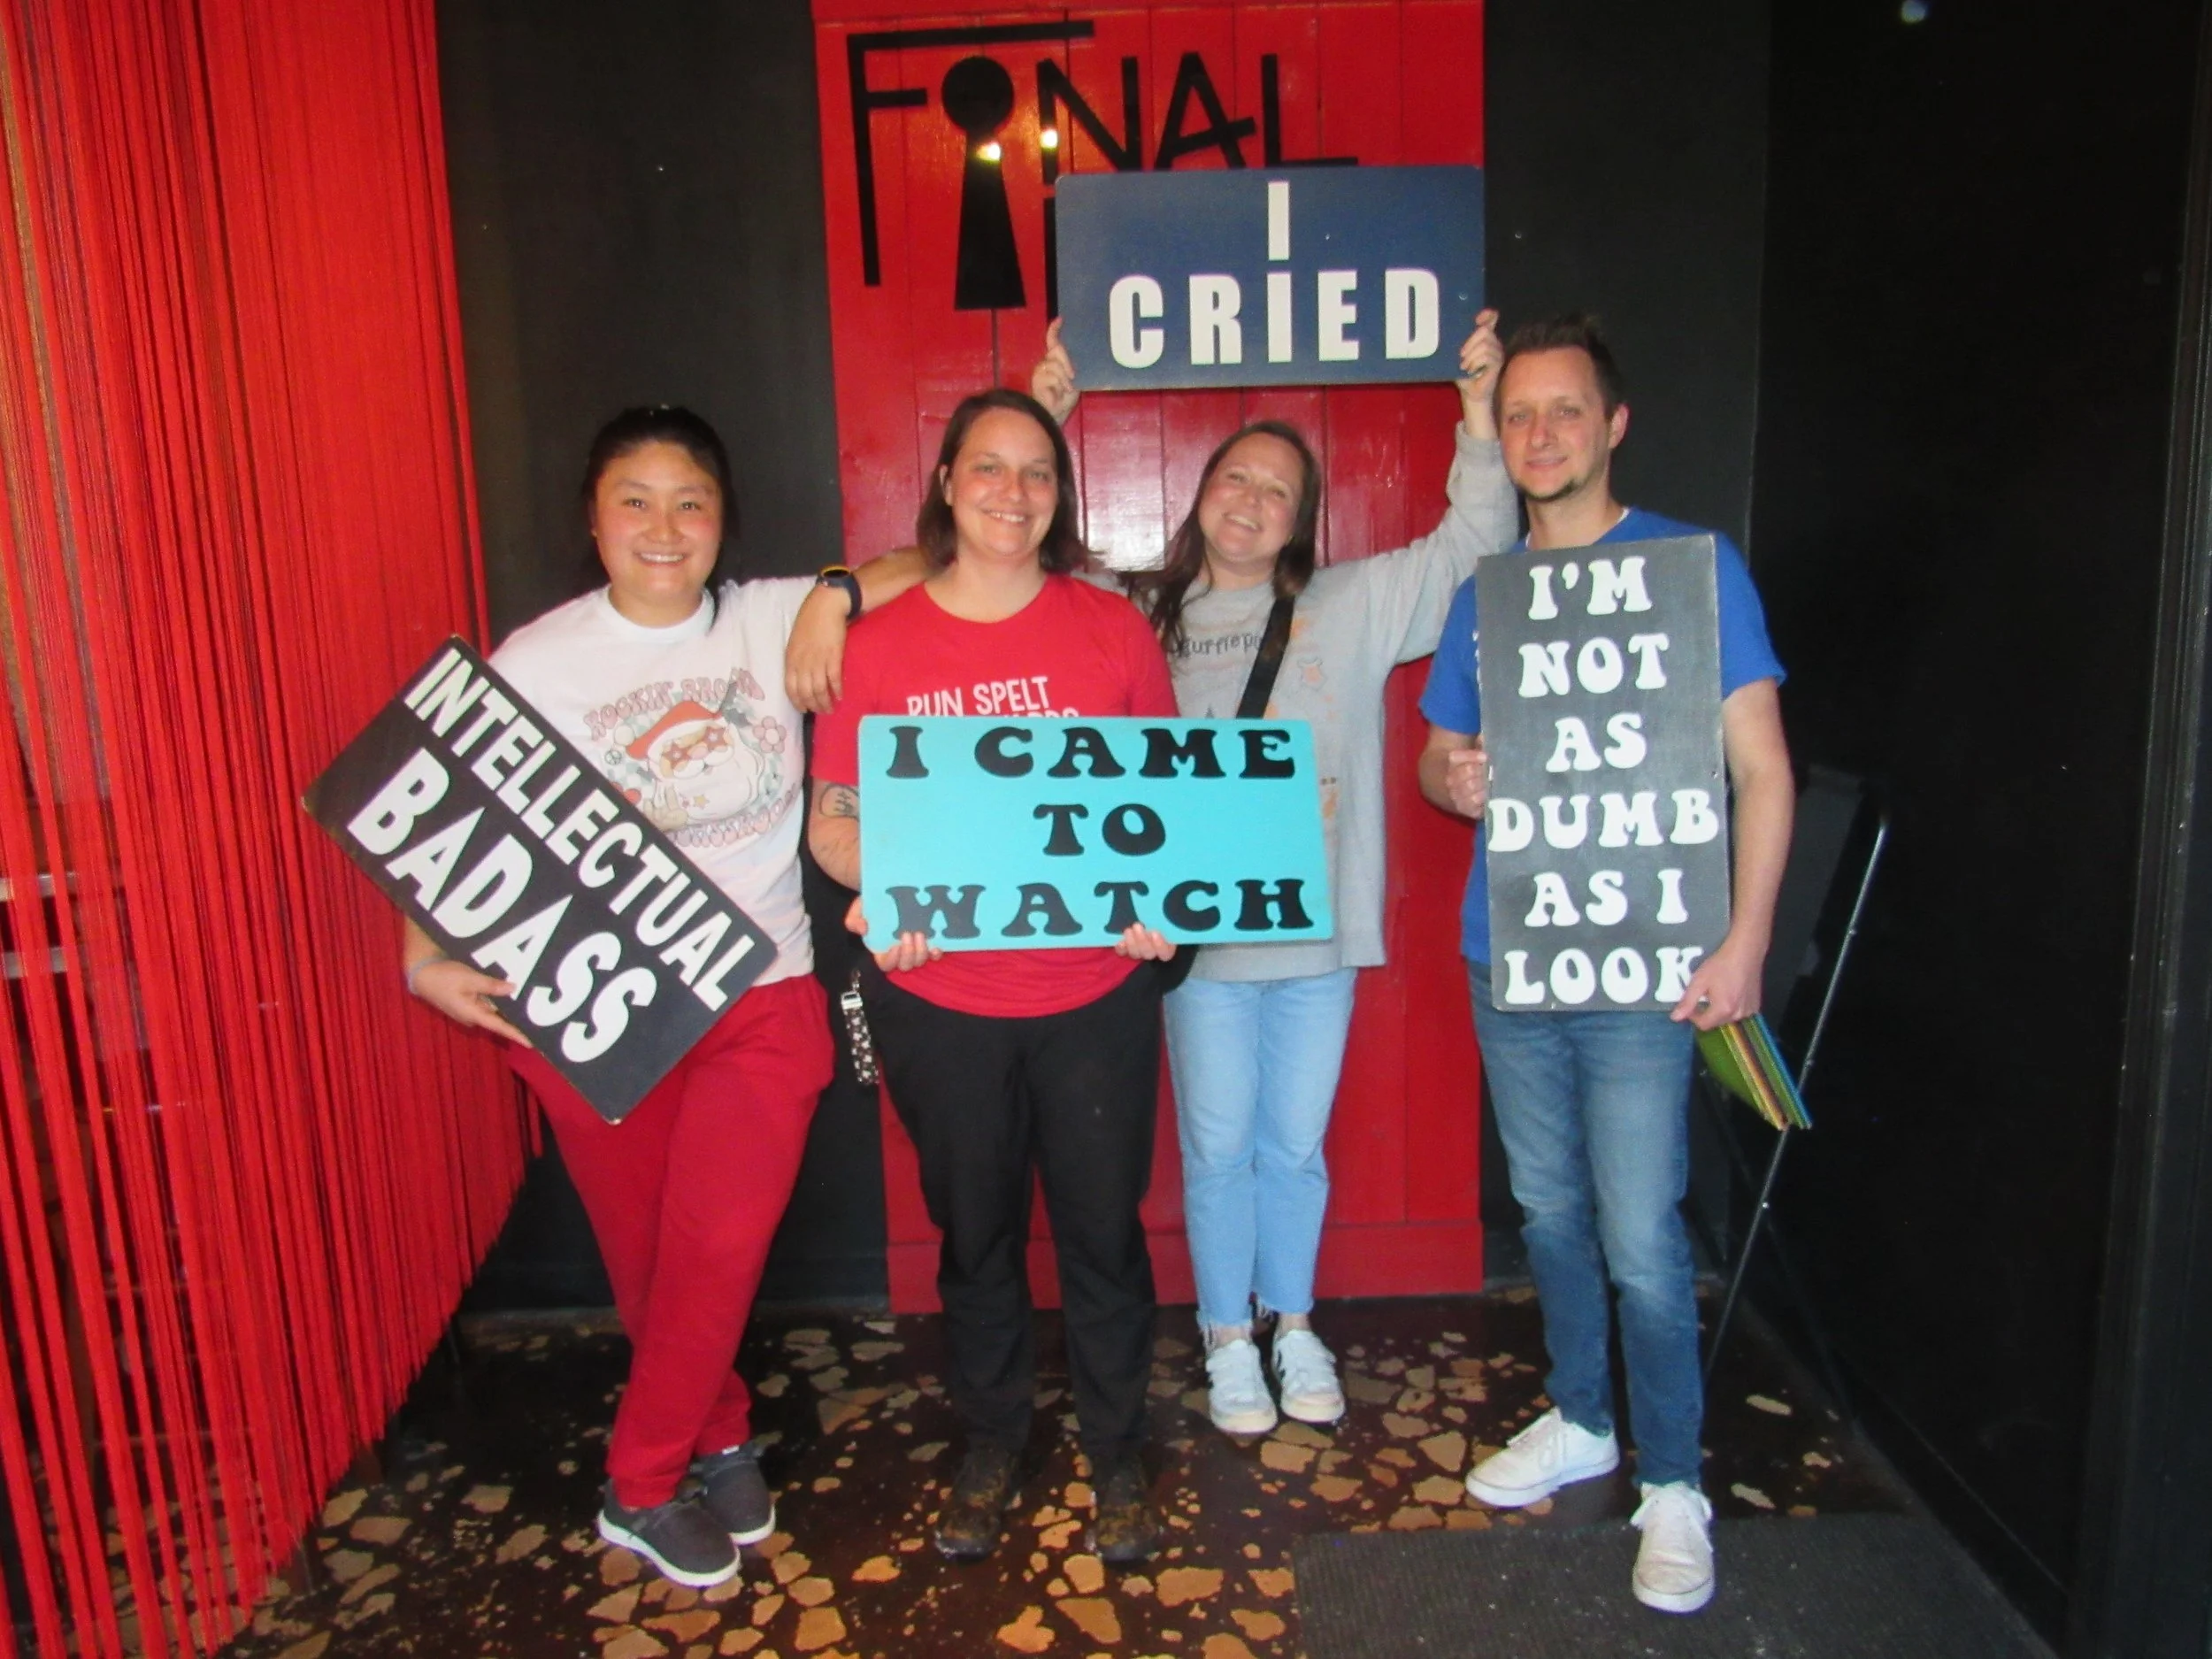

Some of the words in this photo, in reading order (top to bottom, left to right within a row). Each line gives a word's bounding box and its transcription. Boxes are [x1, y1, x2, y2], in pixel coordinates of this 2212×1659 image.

[1268, 180, 1290, 261] I
[1109, 268, 1440, 369] CRIED
[1528, 556, 1653, 620] I'M
[972, 676, 1050, 716] SPELT
[1517, 632, 1671, 698] NOT
[886, 726, 930, 779] I
[974, 726, 1296, 780] CAME
[1545, 711, 1647, 773] AS
[404, 647, 756, 1012] INTELLECTUAL
[1033, 803, 1166, 856] TO
[1487, 787, 1720, 853] DUMB
[347, 748, 657, 1063] BADASS
[885, 878, 1315, 940] WATCH
[1524, 870, 1628, 927] AS
[1655, 868, 1689, 925] I
[1504, 947, 1704, 1004] LOOK
